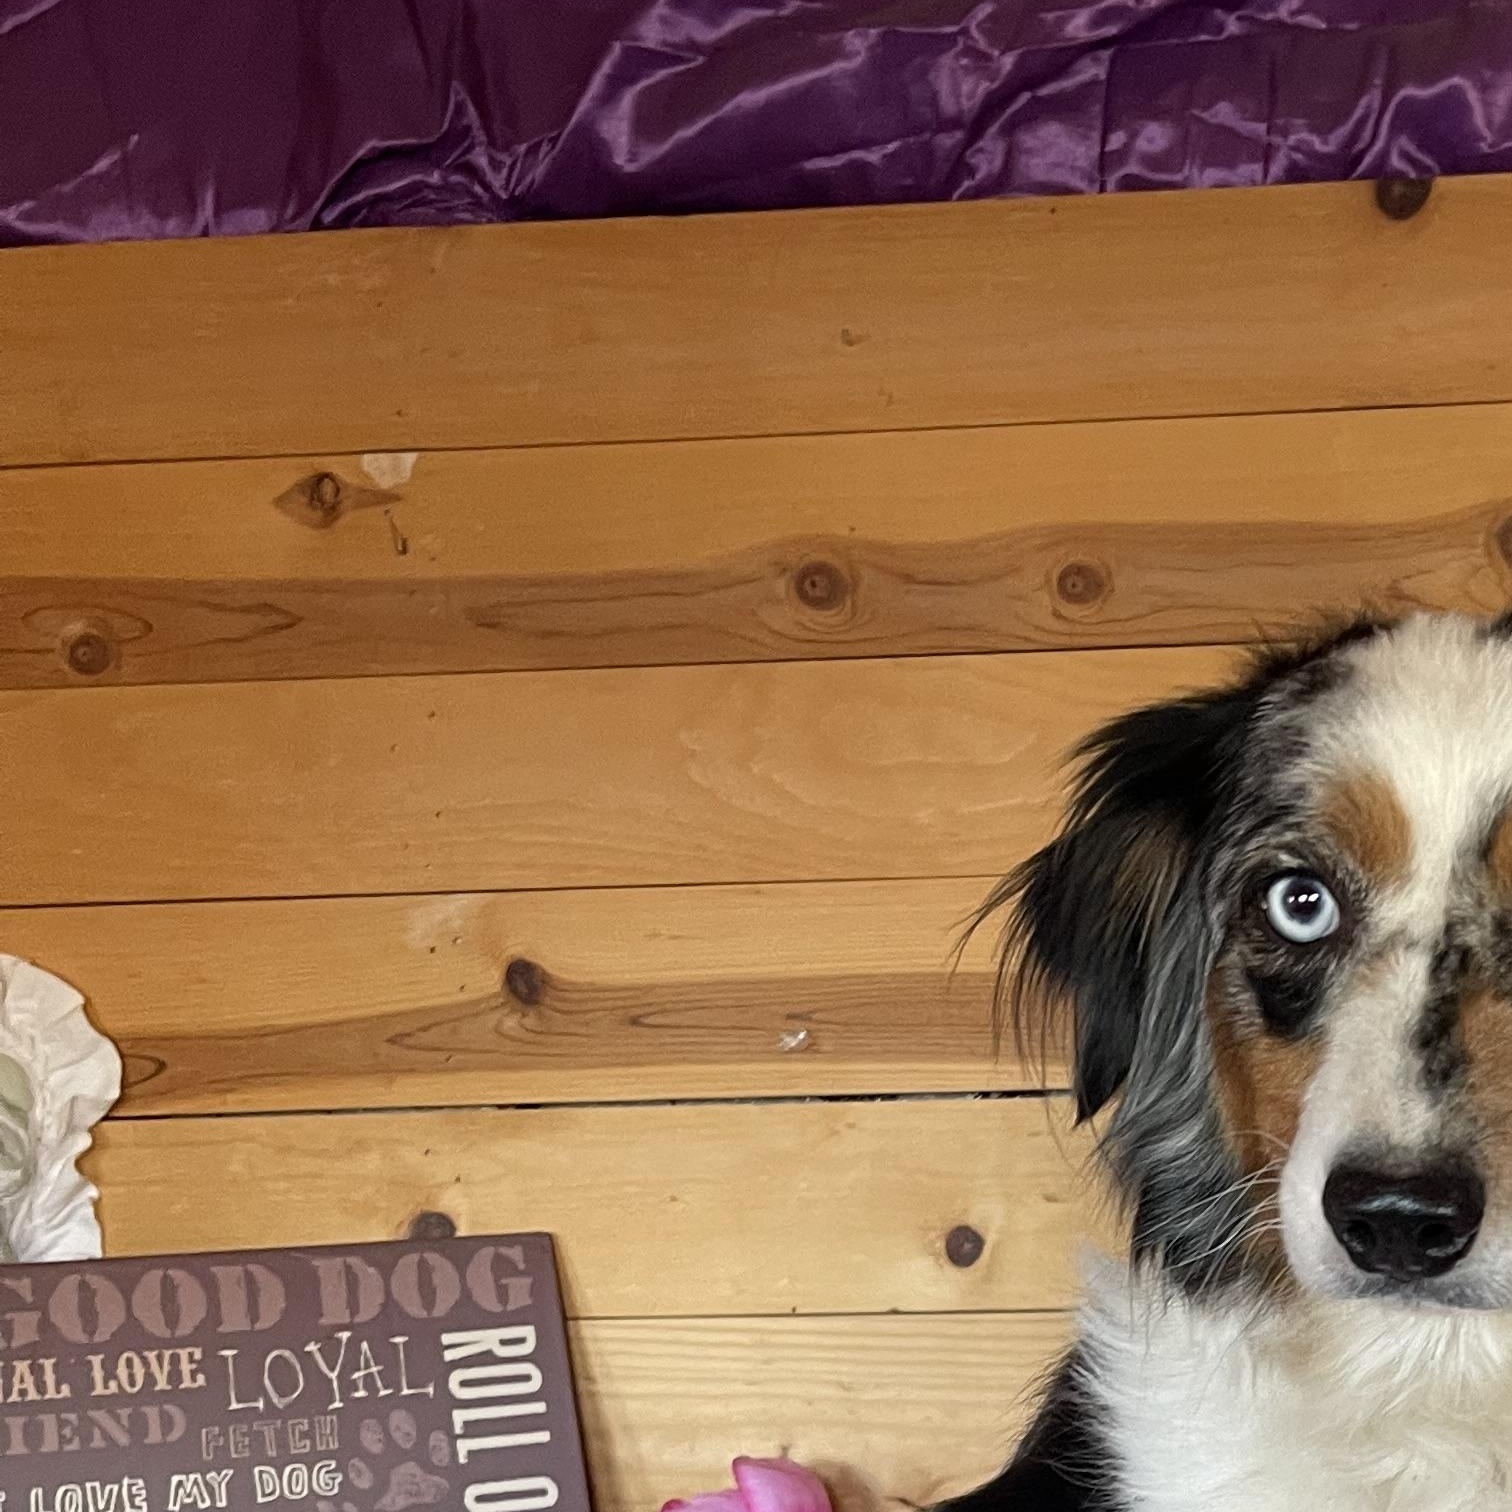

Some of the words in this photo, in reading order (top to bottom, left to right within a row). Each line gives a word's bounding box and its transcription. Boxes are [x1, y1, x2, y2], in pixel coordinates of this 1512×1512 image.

[310, 1245, 533, 1326] DOG
[0, 1357, 71, 1402] AL
[85, 1346, 206, 1397] LOVE
[217, 1331, 434, 1412] LOYAL
[441, 1325, 551, 1464] ROLL
[201, 1414, 339, 1461] FETCH
[254, 1459, 343, 1504] DOG
